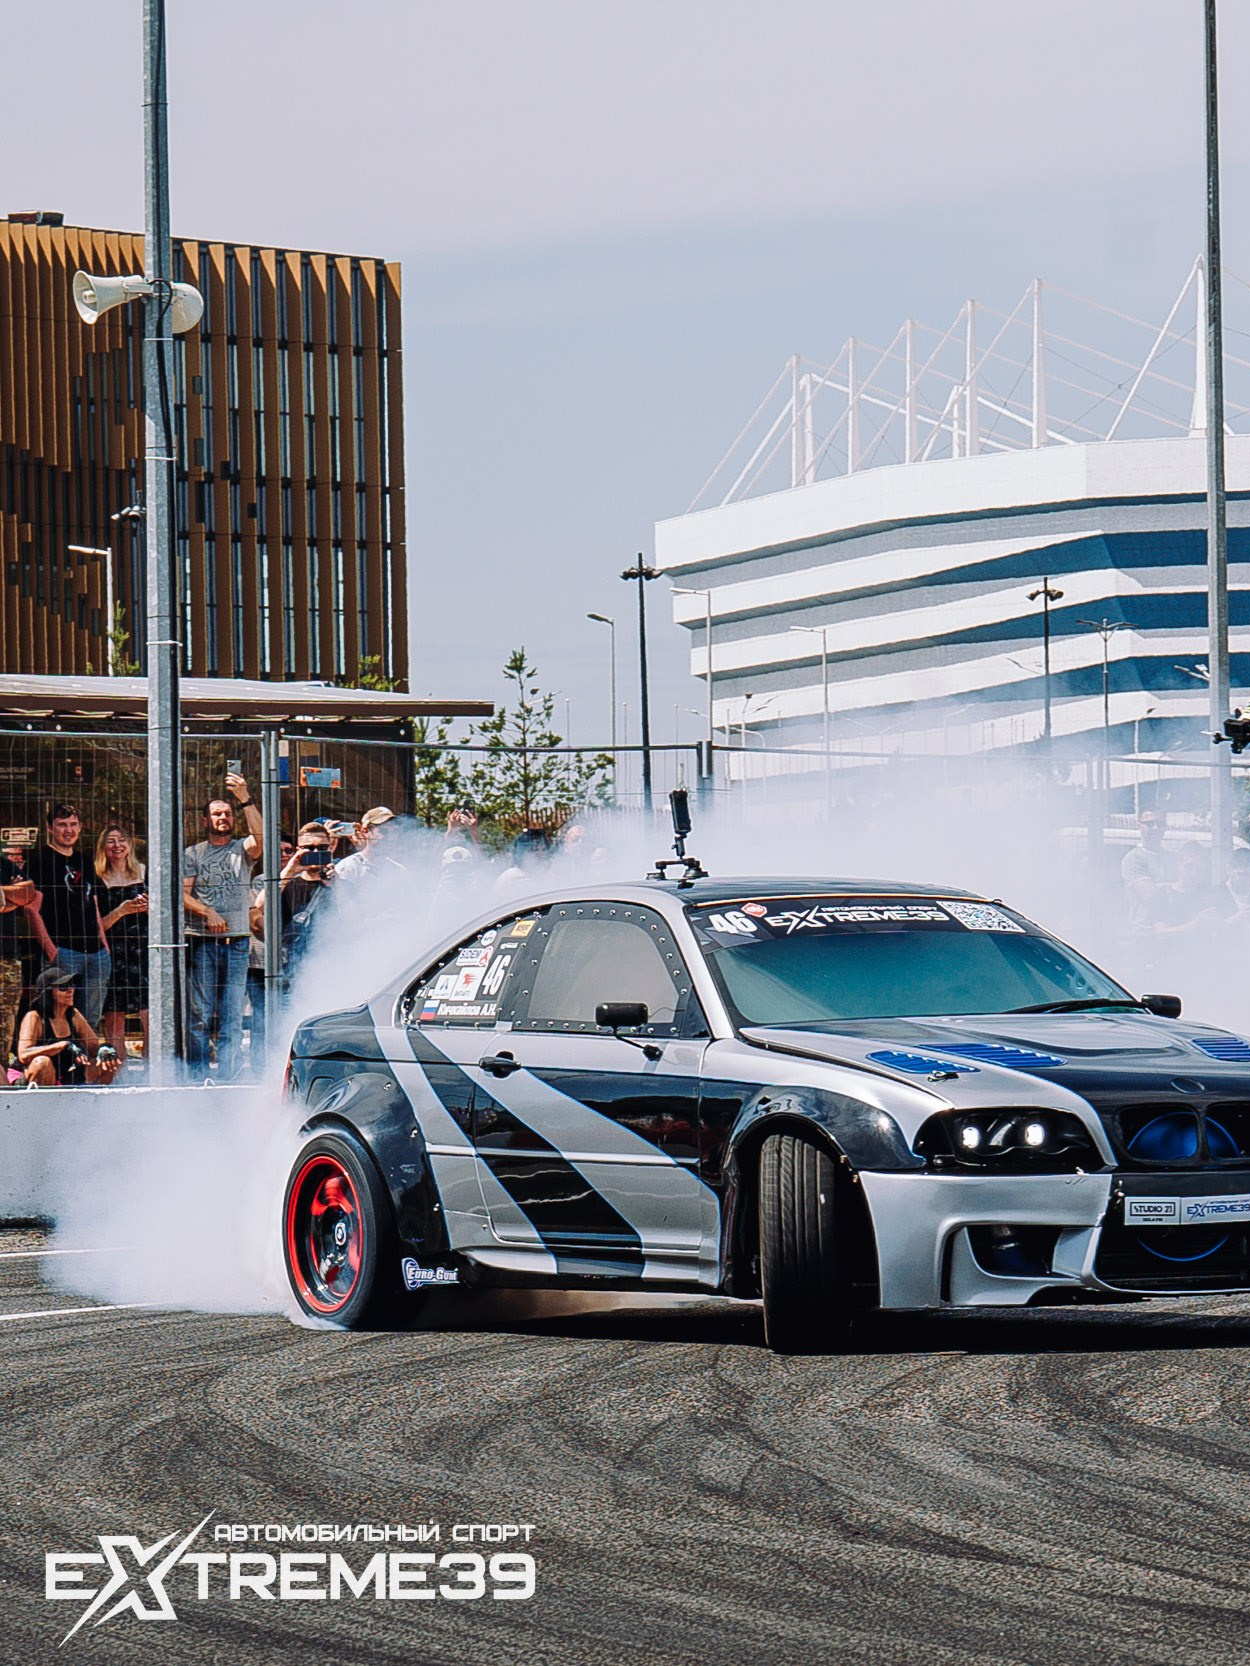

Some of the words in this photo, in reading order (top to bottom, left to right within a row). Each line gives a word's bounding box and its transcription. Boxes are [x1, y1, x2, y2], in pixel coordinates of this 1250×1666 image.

[708, 911, 758, 934] 46
[764, 905, 950, 934] EXTREME39
[482, 955, 511, 995] 46
[1134, 1205, 1163, 1213] STUDIO
[1164, 1205, 1173, 1213] 21
[1187, 1200, 1250, 1221] EXTREME39
